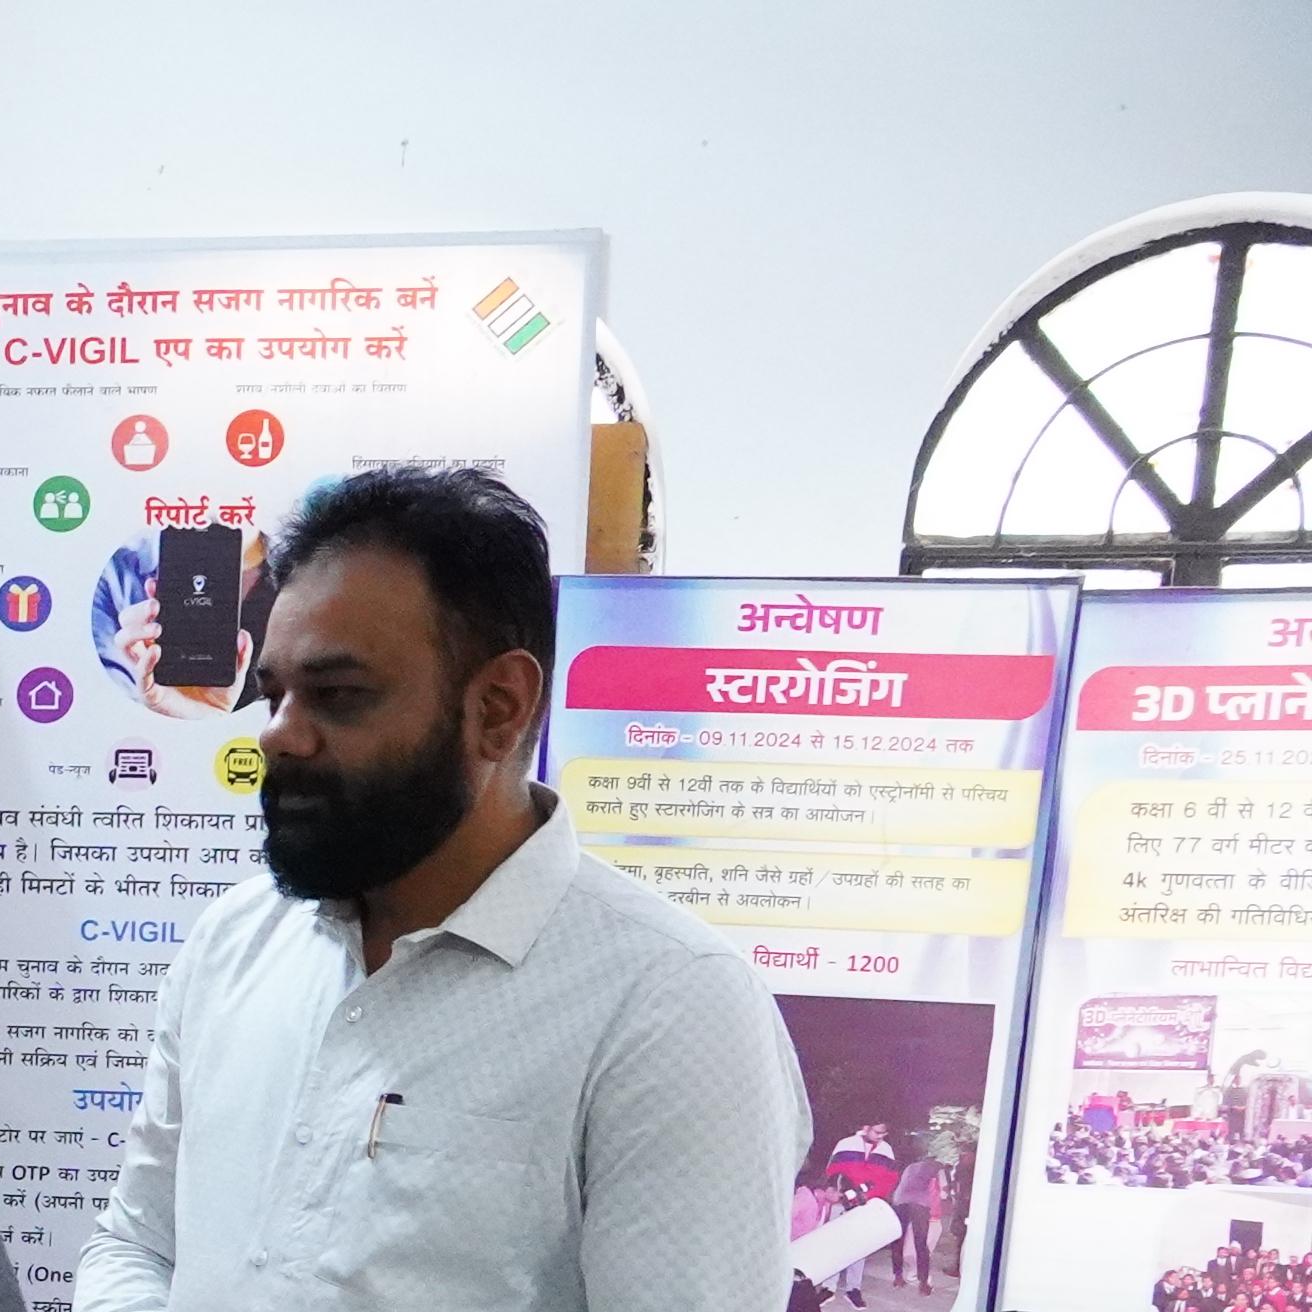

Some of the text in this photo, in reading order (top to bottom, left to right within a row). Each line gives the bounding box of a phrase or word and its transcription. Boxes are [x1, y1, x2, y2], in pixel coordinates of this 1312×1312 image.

[67, 282, 93, 317] के
[107, 280, 178, 320] दौरान
[192, 287, 263, 313] सजग
[277, 277, 381, 313] नागरिक
[396, 275, 439, 311] बनें
[3, 324, 408, 367] C-VIGIL एप का उपयोग करें
[99, 384, 122, 397] वाले
[127, 384, 158, 396] भाषण
[145, 496, 256, 526] रिपोर्ट करें
[737, 595, 883, 636] अन्वेषण
[705, 658, 907, 708] स्टारगेजिंग
[1132, 685, 1194, 722] 3D
[628, 726, 973, 753] दिनांक 09.11.2024 से 15.12.2024 तक
[234, 758, 253, 766] FREE
[1144, 747, 1194, 767] दिनांक
[589, 774, 619, 791] कक्षा
[658, 773, 669, 792] से
[719, 779, 743, 793] तक
[751, 776, 764, 793] के
[771, 776, 837, 799] विद्यार्थियों
[844, 779, 862, 797] को
[869, 779, 934, 804] एस्ट्रोनॉमी
[942, 782, 955, 798] से
[963, 784, 1008, 803] परिचय
[29, 804, 81, 829] संबंधी
[93, 805, 145, 830] त्वरित
[154, 805, 236, 831] शिकायत
[586, 797, 799, 820] कराते हुए स्टारगेजिंग के सत्र का
[1131, 797, 1292, 820] कक्षा 6 वीं से 12
[51, 839, 116, 863] जिसका
[127, 840, 190, 864] उपयोग
[200, 848, 240, 864] आप
[1127, 833, 1296, 857] लिए 77 वर्ग मीटर
[21, 870, 76, 895] मिनटों
[85, 873, 105, 896] के
[116, 873, 161, 897] भीतर
[722, 865, 748, 881] शनि
[755, 866, 781, 882] जैसे
[886, 869, 904, 888] की
[911, 875, 943, 890] सतह
[952, 876, 970, 891] का
[1160, 871, 1236, 895] गुणवत्ता
[1249, 867, 1267, 889] के
[718, 889, 729, 905] से
[1119, 903, 1221, 925] अंतरिक्ष की
[80, 919, 185, 944] C-VIGIL
[17, 959, 59, 979] चुनाव
[66, 954, 83, 975] के
[90, 957, 129, 976] दौरान
[753, 947, 899, 973] विद्यार्थी 1200
[1172, 957, 1268, 978] लाभान्वित
[49, 981, 65, 1001] के
[72, 985, 100, 1004] द्वारा
[7, 1026, 45, 1040] सजग
[54, 1022, 109, 1041] नागरिक
[118, 1024, 138, 1041] को
[22, 1047, 66, 1066] सक्रिय
[76, 1050, 97, 1071] एवं
[29, 1129, 45, 1142] पर
[55, 1127, 84, 1148] जाएं
[12, 1166, 50, 1181] OTP
[59, 1167, 79, 1181] का
[3, 1189, 26, 1207] करें
[35, 1192, 84, 1212] (अपनी
[27, 1267, 73, 1283] (One
